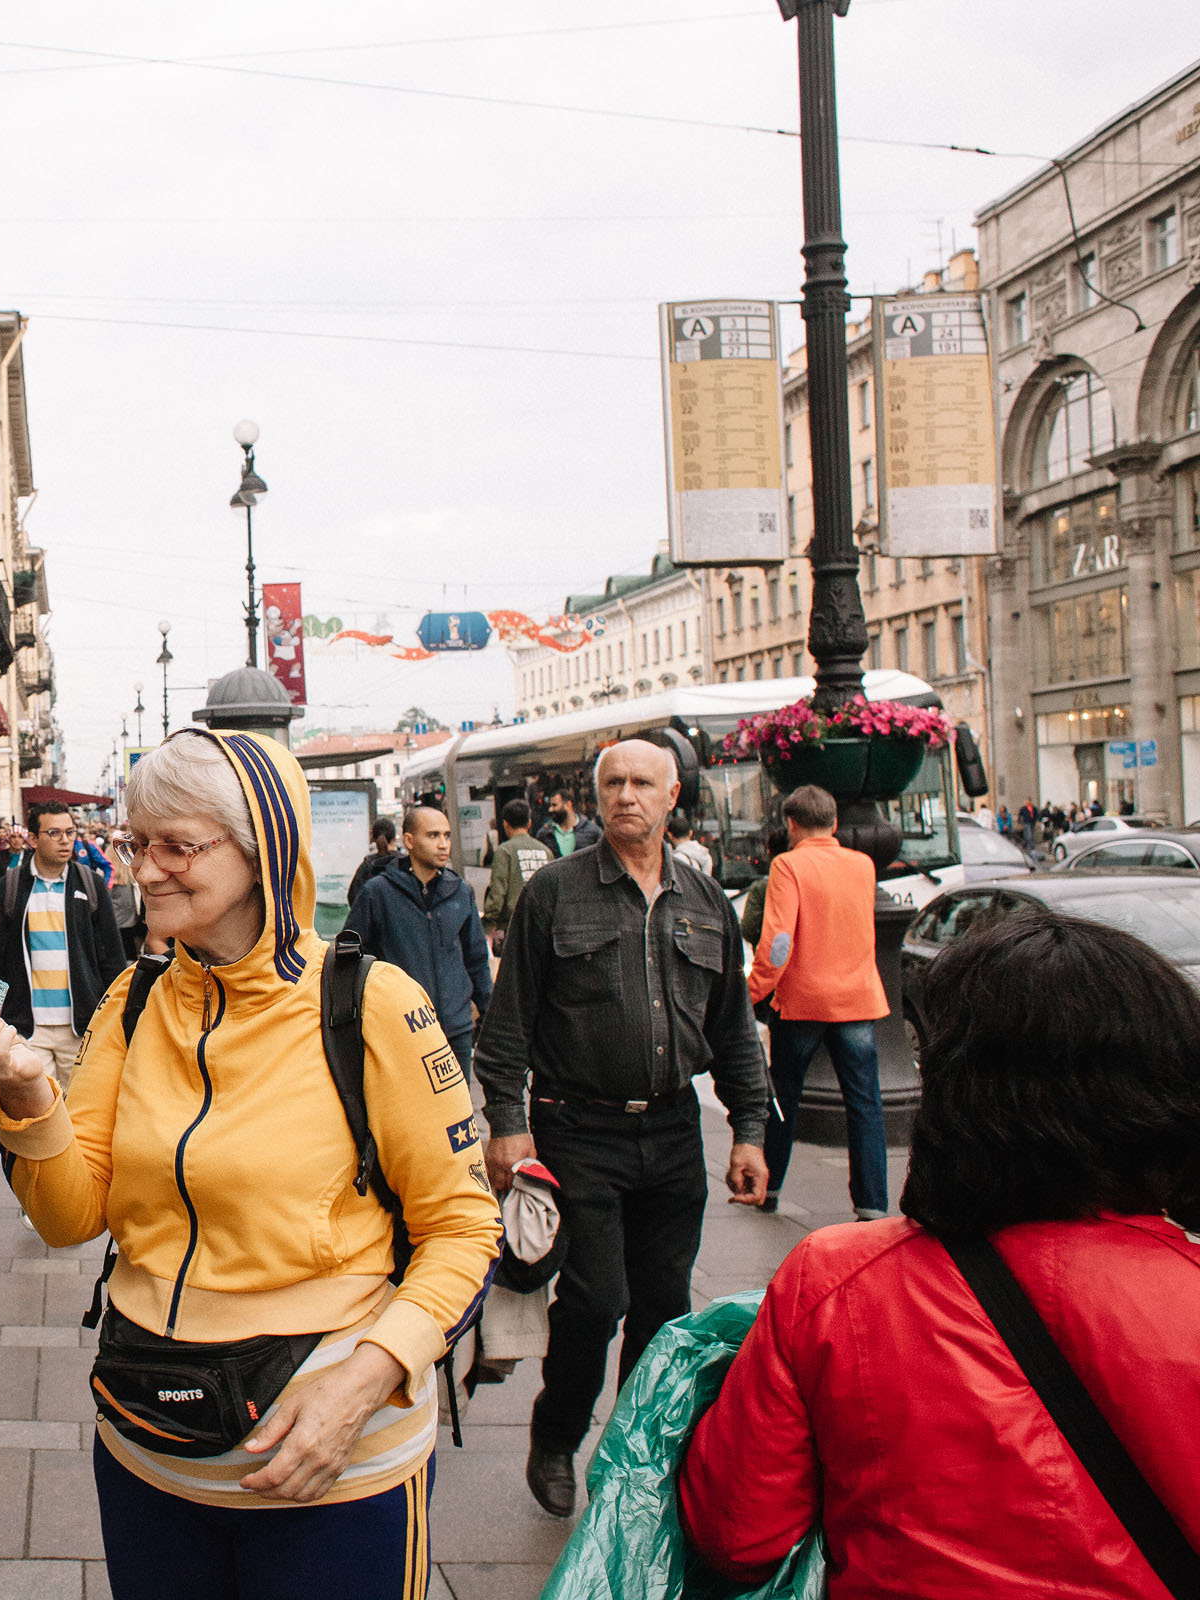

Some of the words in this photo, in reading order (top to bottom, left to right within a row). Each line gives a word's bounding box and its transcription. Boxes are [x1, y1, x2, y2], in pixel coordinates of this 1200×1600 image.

[939, 328, 954, 339] 24
[937, 342, 957, 353] 191
[1072, 533, 1129, 577] ZAR
[431, 1060, 453, 1079] THE
[157, 1388, 204, 1402] SPORTS
